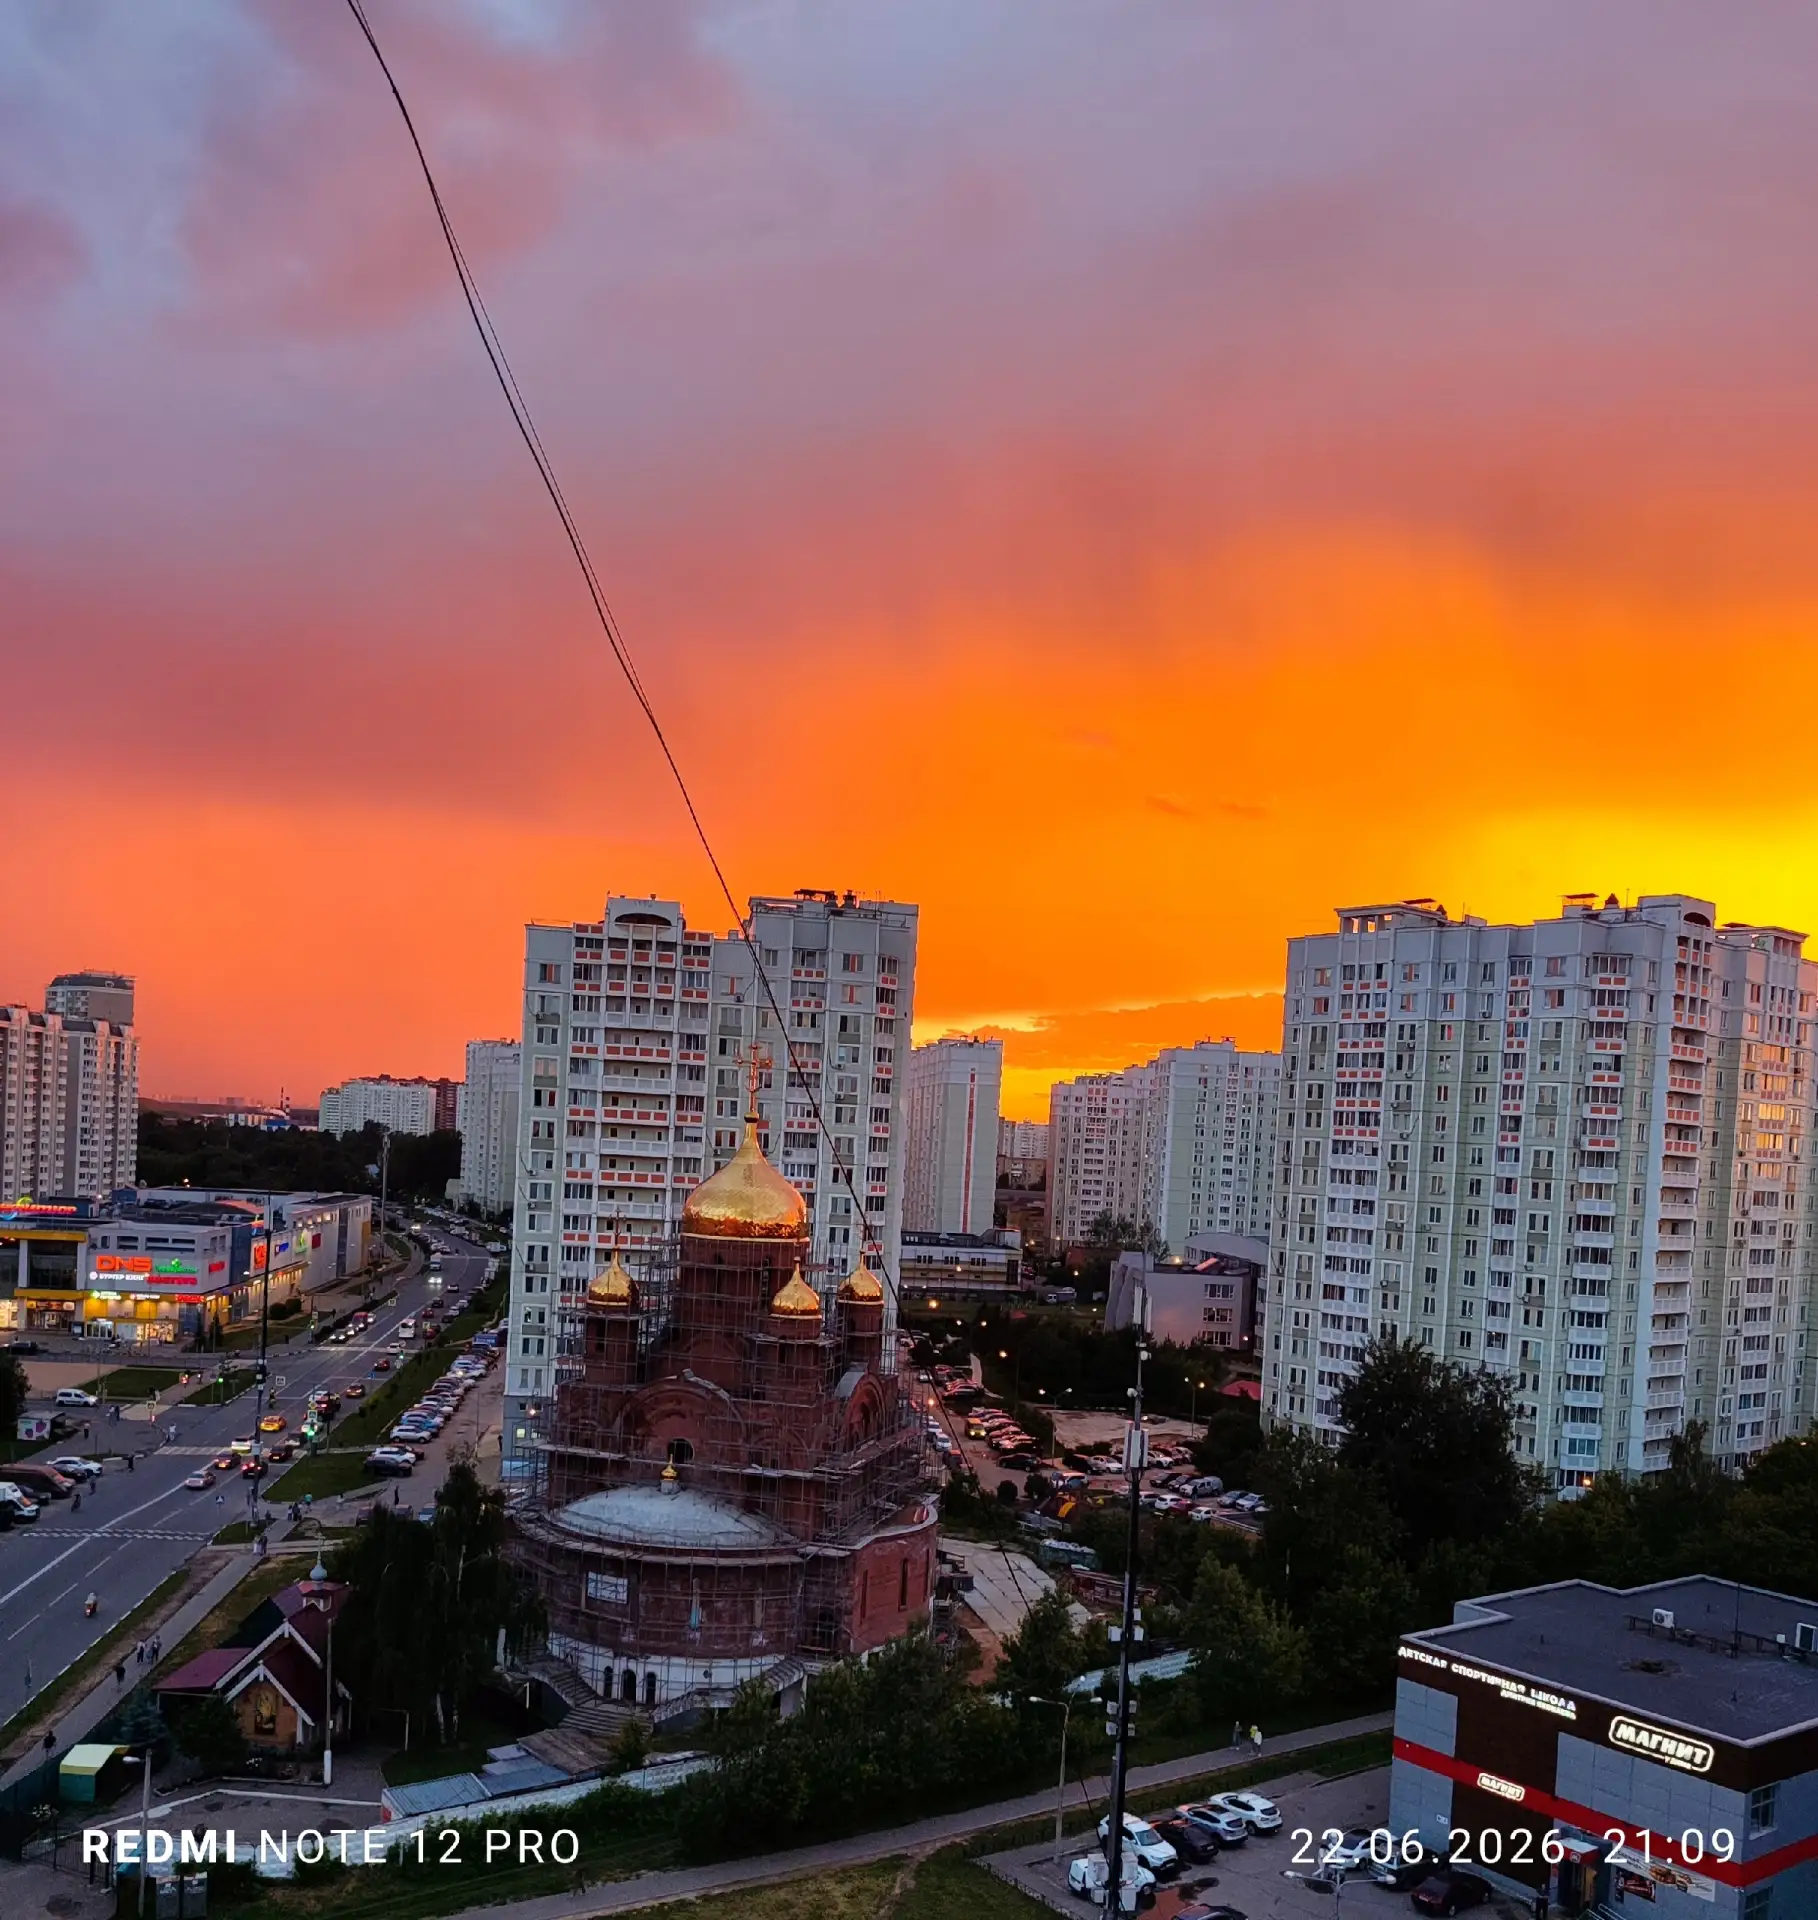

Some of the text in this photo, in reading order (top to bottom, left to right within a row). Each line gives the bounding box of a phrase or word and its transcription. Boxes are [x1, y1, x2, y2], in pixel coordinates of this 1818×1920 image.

[96, 1256, 152, 1272] DNS
[1397, 1646, 1448, 1669] ДЕТСКАЯ
[1451, 1663, 1526, 1694] СПОРТИВНАЯ
[1530, 1688, 1577, 1712] ШКОЛА
[1616, 1723, 1708, 1765] МАГНИТ
[1480, 1776, 1522, 1799] МАГНИТ
